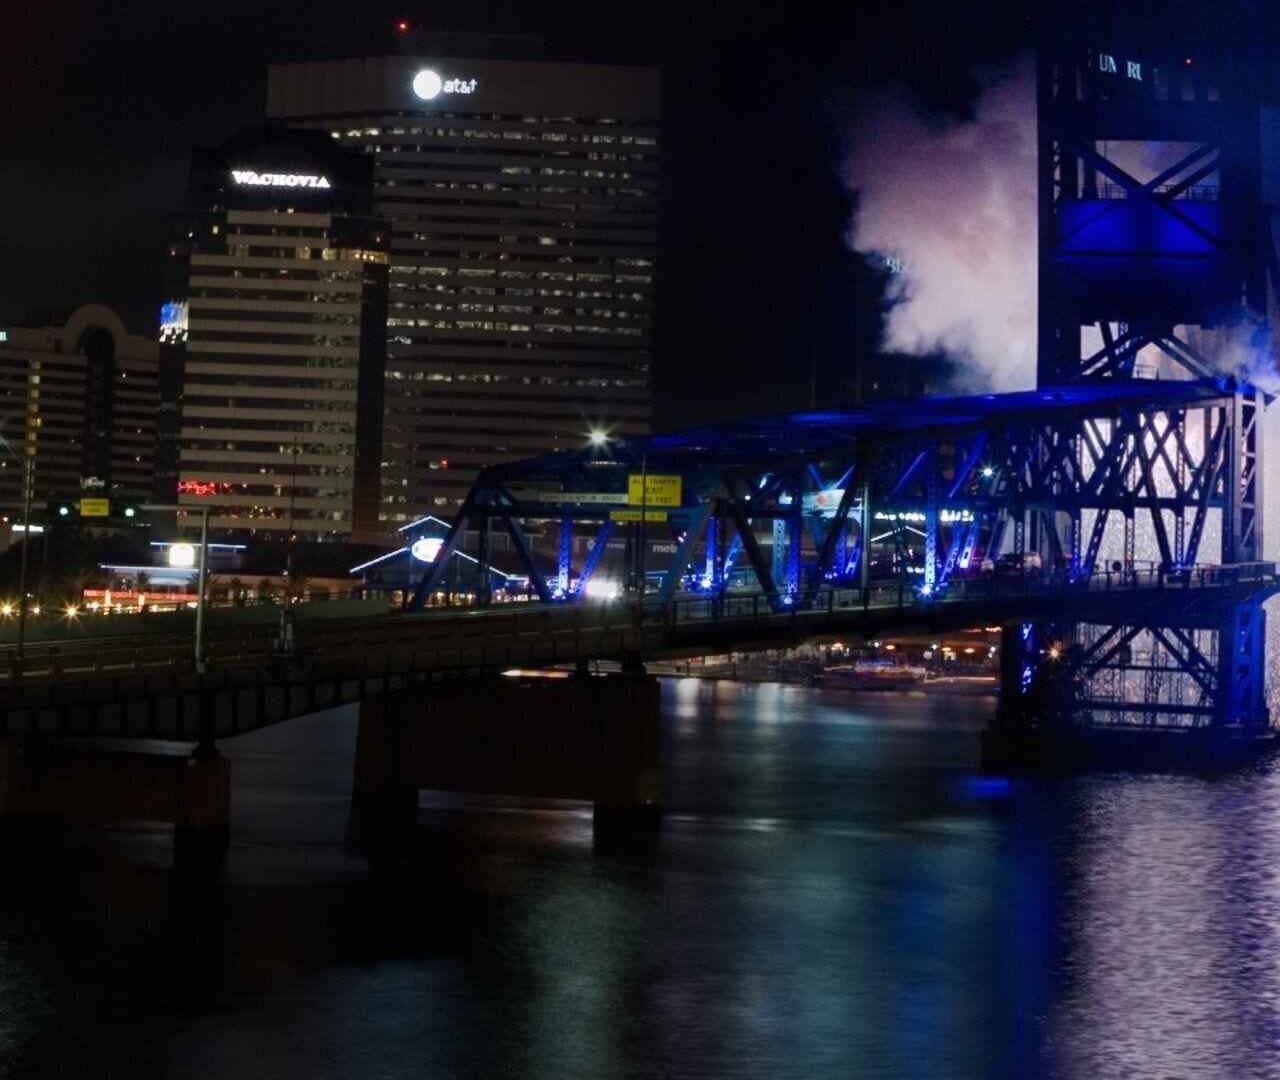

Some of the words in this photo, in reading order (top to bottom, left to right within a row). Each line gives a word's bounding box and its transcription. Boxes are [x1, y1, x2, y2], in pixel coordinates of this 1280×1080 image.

[443, 77, 478, 95] at&t
[231, 170, 331, 189] WACHOVIA
[648, 477, 679, 486] TRAFFIC
